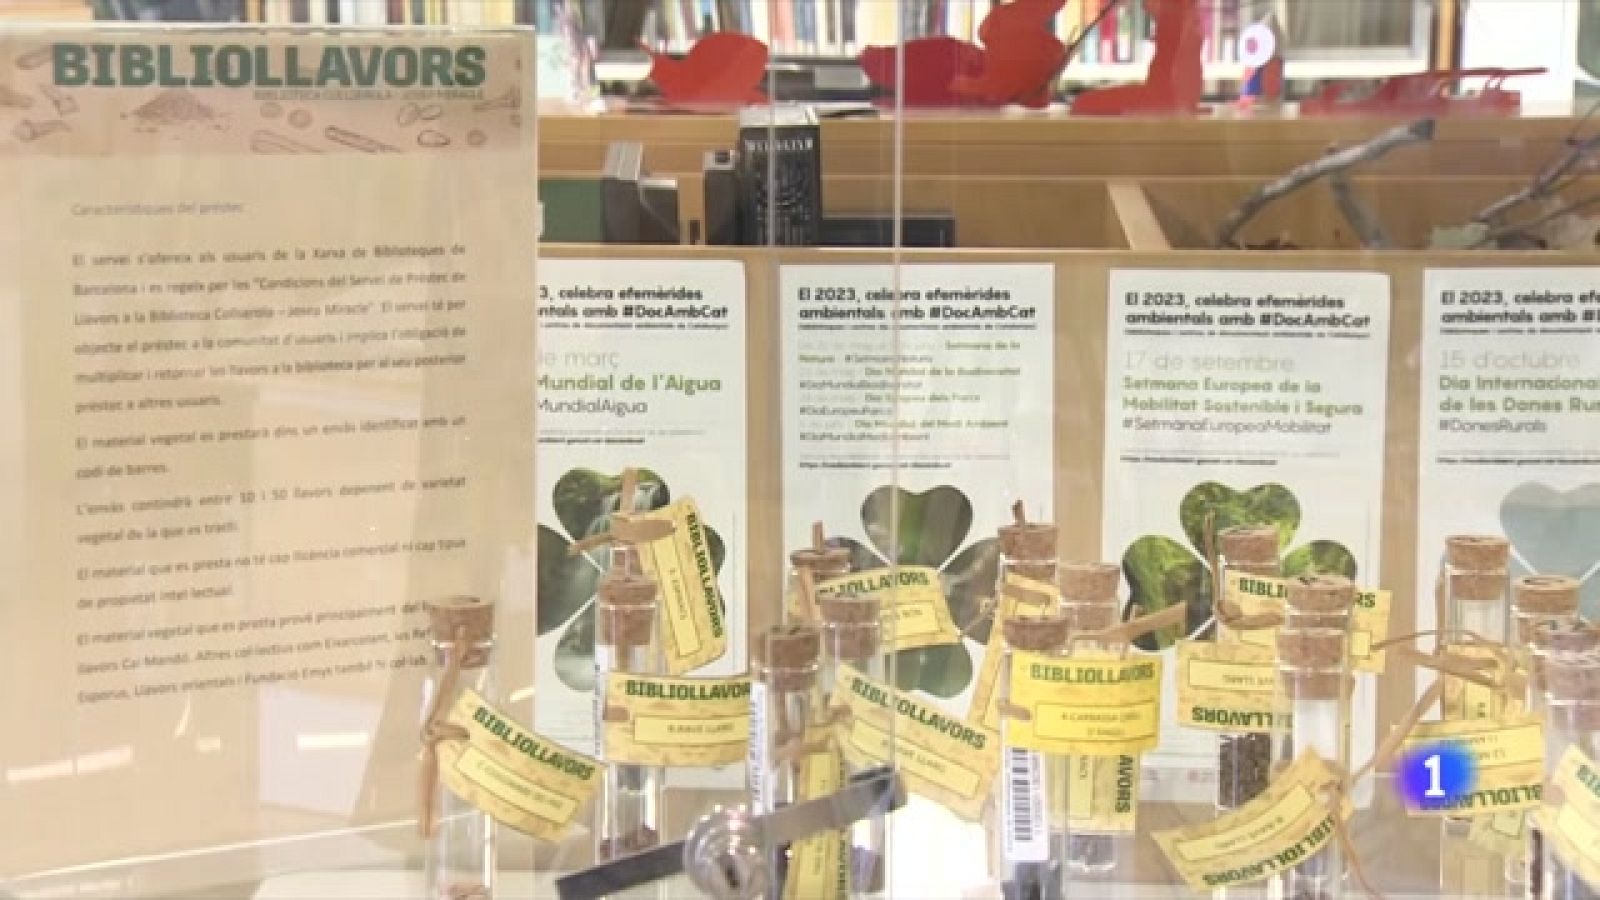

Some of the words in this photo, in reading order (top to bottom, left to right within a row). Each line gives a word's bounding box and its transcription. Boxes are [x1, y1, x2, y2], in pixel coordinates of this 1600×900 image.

[52, 43, 487, 87] BIBLIOLLAVORS
[374, 244, 446, 260] Biblioteques
[559, 285, 613, 300] celebra
[618, 284, 703, 300] efemèrides
[798, 286, 811, 301] El
[814, 286, 861, 304] 2023,
[925, 284, 1011, 301] efemèrides
[1124, 291, 1139, 306] El
[1142, 291, 1190, 309] 2023,
[1195, 293, 1251, 307] celebra
[1256, 292, 1345, 308] efemèrides
[1440, 289, 1456, 305] El
[1459, 289, 1508, 307] 2023,
[1514, 289, 1574, 305] celebra
[149, 309, 211, 322] Biblioteca
[538, 304, 578, 317] ntals
[583, 304, 618, 317] amb
[622, 304, 729, 318] #DocAmbCat
[798, 305, 886, 319] ambientals
[929, 304, 1036, 319] #DocAmbCat
[1125, 309, 1214, 326] ambientals
[1219, 311, 1256, 326] amb
[1260, 312, 1371, 328] #DocAmbCat
[1441, 308, 1534, 323] ambientals
[1539, 307, 1577, 323] amb
[294, 359, 353, 373] biblioteca
[1126, 351, 1146, 370] 17
[1154, 353, 1184, 371] de
[1192, 355, 1295, 373] setembre
[1440, 349, 1466, 370] 15
[1472, 348, 1581, 370] d'octubre
[620, 373, 646, 391] de
[652, 373, 722, 396] l'Aigua
[1123, 375, 1198, 391] Setmana
[1203, 376, 1273, 395] Europea
[1278, 377, 1300, 393] de
[1304, 378, 1321, 393] la
[1439, 374, 1471, 391] Dia
[1475, 374, 1600, 391] Internaciona
[537, 397, 648, 418] MundialAigua
[1122, 396, 1197, 412] Mobilitat
[1203, 398, 1290, 414] Sostenible
[1304, 400, 1364, 418] Segura
[1439, 396, 1463, 412] de
[1469, 395, 1497, 412] les
[1502, 396, 1563, 413] Dones
[1122, 417, 1331, 435] #SetmanaEuropeaMobilitat
[1439, 417, 1548, 433] #DonesRurals
[91, 434, 146, 448] material
[150, 430, 196, 447] vegetal
[76, 529, 123, 546] vegetal
